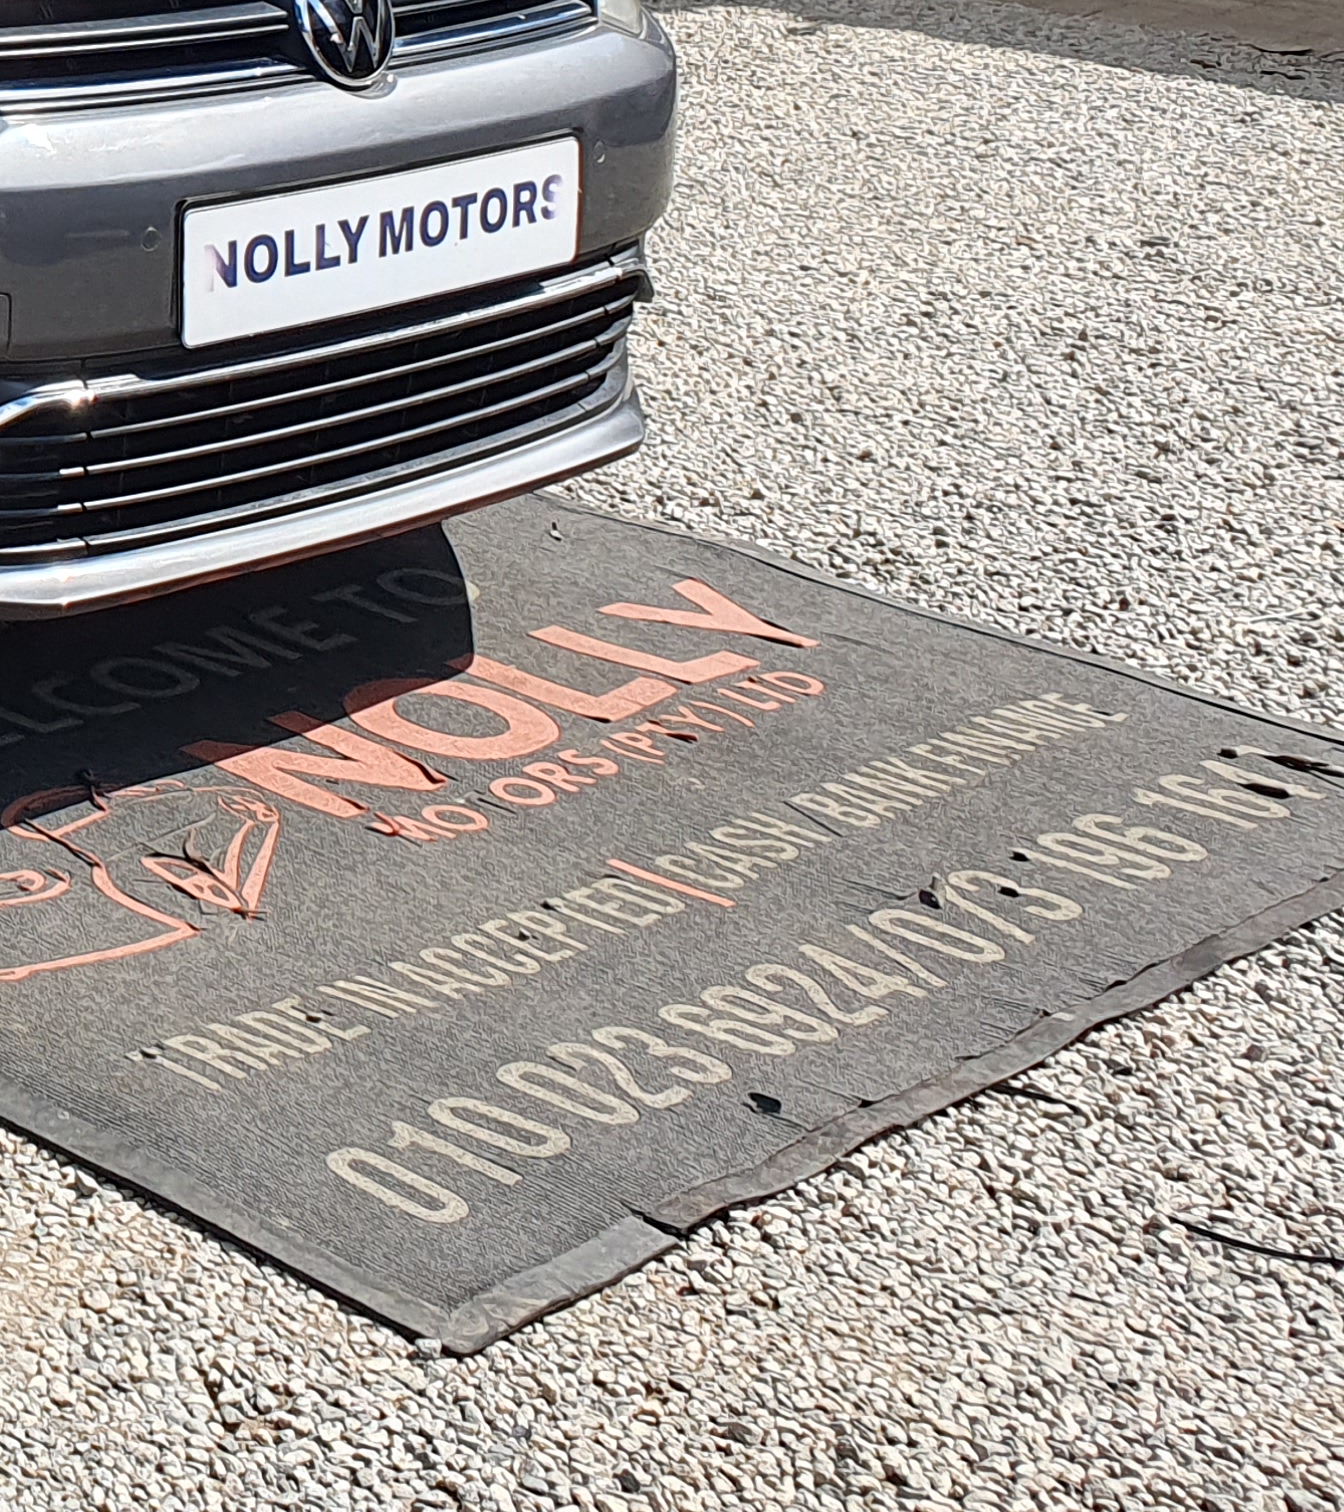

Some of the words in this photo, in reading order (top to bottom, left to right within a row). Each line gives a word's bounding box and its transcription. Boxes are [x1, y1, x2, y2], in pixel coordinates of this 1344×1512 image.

[205, 213, 370, 291] NOLLY
[378, 173, 564, 258] MOTORS
[179, 577, 822, 819] NOLLY
[312, 566, 481, 624] TO
[369, 748, 621, 842] MOORS
[716, 670, 826, 712] LTD
[124, 993, 373, 1091] TRADE
[316, 974, 441, 1019] IN
[389, 877, 686, 1000] ACCEPTED
[655, 811, 833, 890] CASH
[788, 756, 967, 829] BANK
[906, 692, 1129, 777] FINANCE
[326, 1095, 573, 1226] 010
[495, 1003, 733, 1125] 023
[1010, 813, 1208, 890] 196
